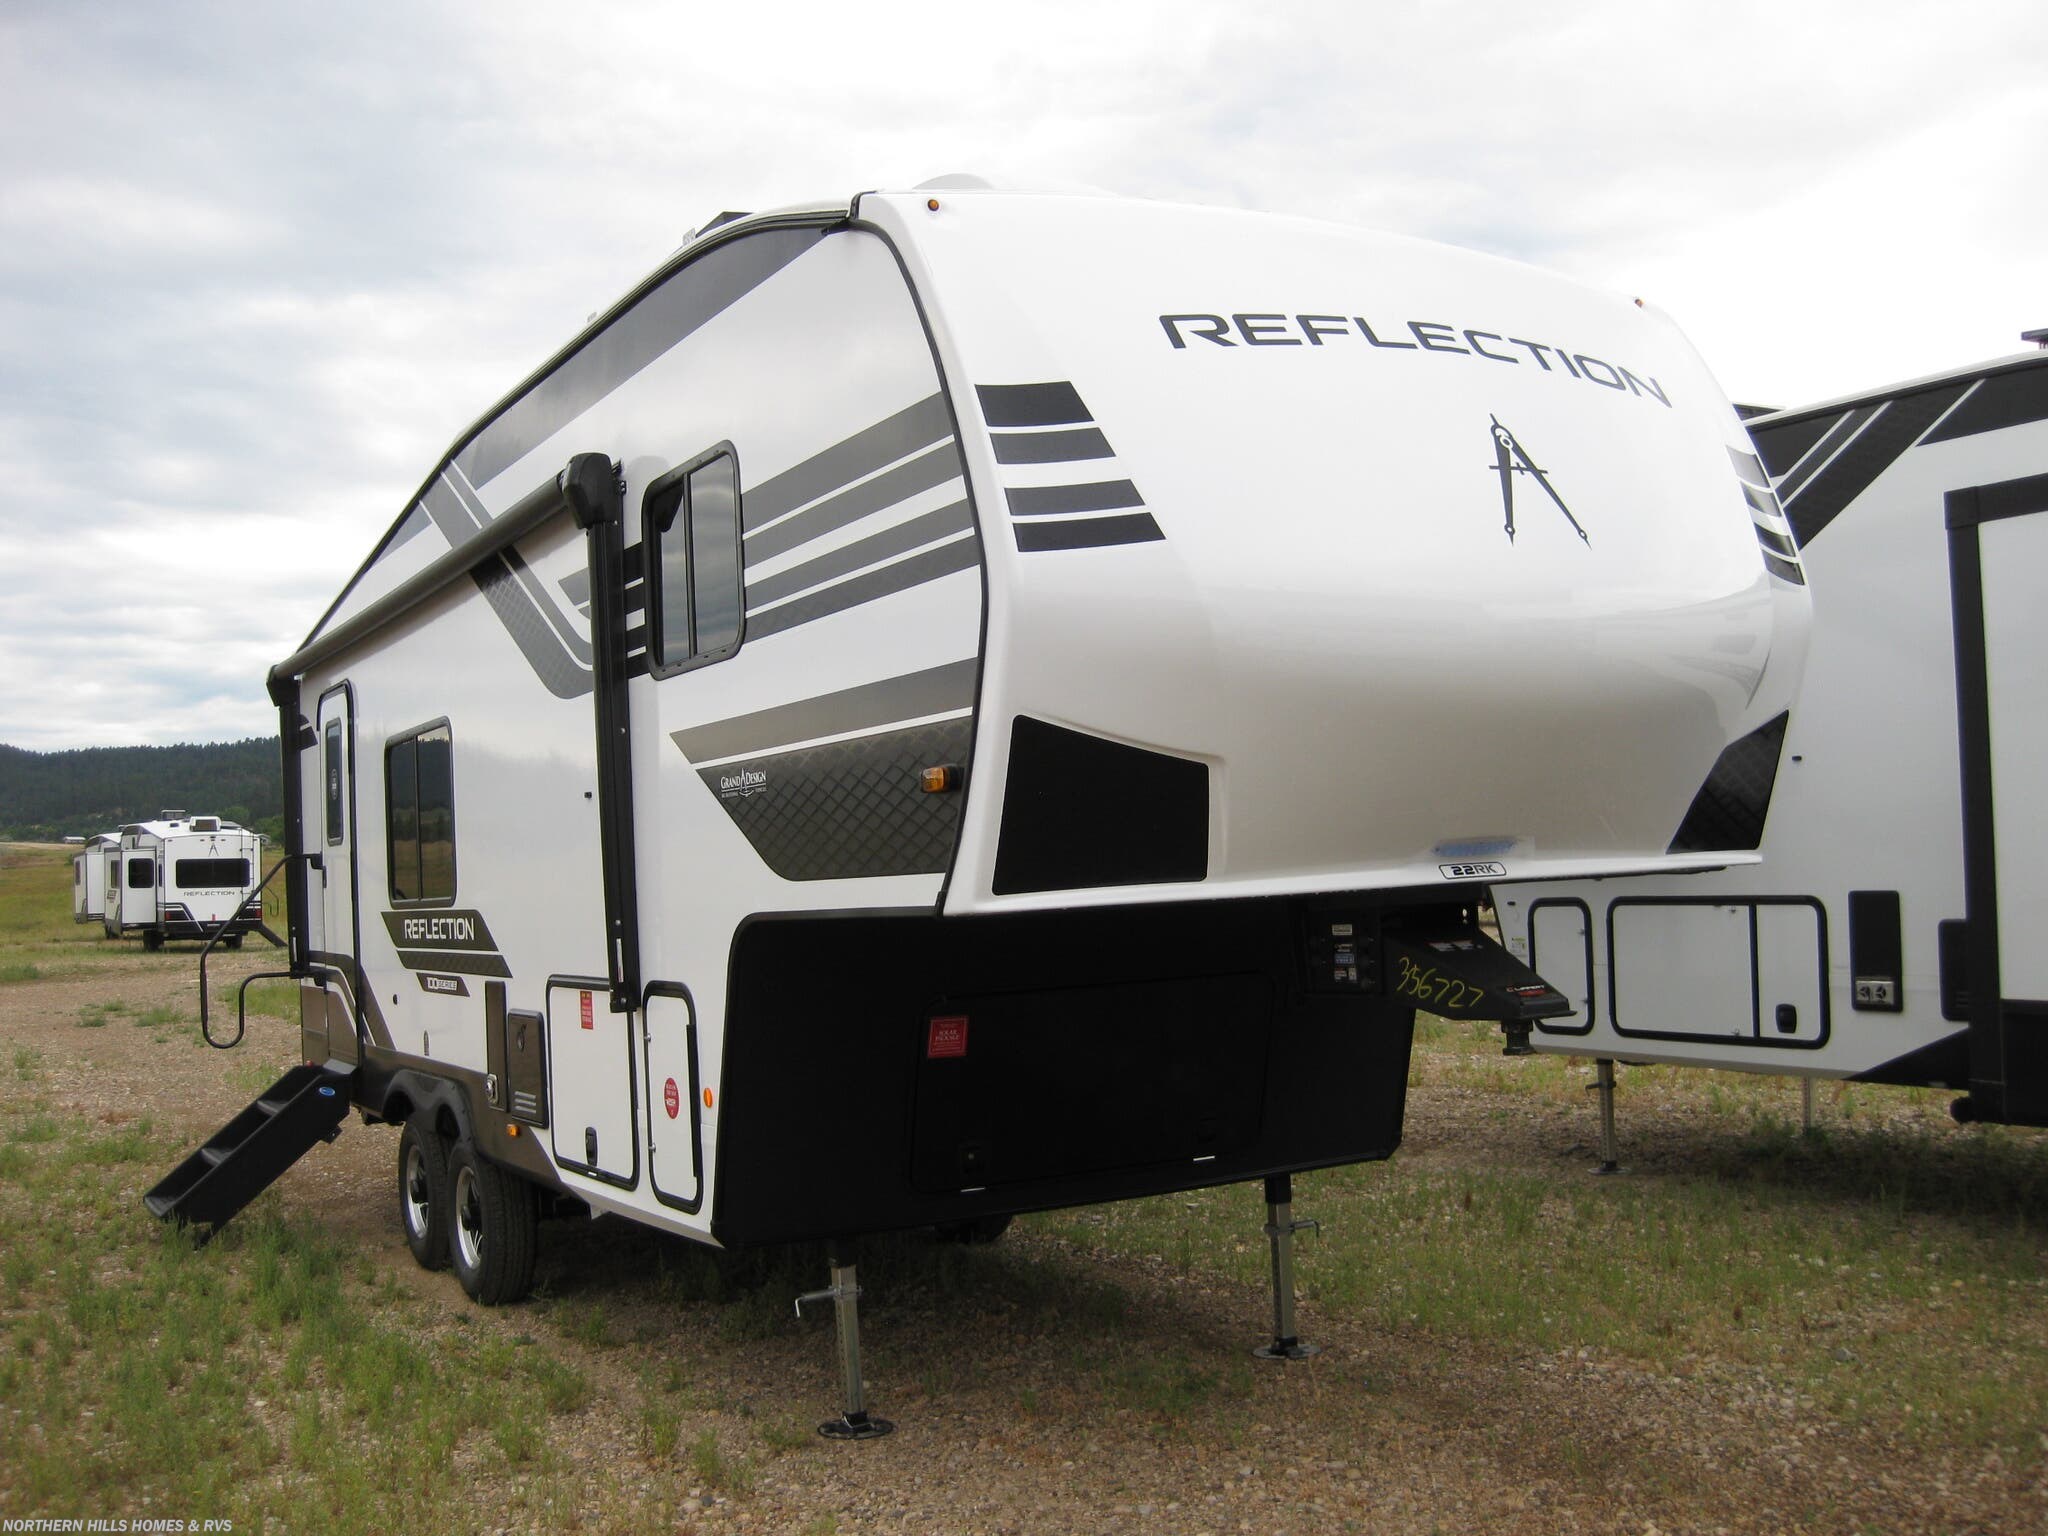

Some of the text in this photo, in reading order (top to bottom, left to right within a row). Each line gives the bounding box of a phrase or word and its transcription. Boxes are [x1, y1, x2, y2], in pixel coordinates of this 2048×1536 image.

[1159, 313, 1673, 408] REFLECTION
[720, 769, 767, 789] GRAND DESIGN
[1452, 863, 1497, 876] 22RK
[404, 917, 475, 941] REFLECTION
[1396, 956, 1484, 1008] 356727
